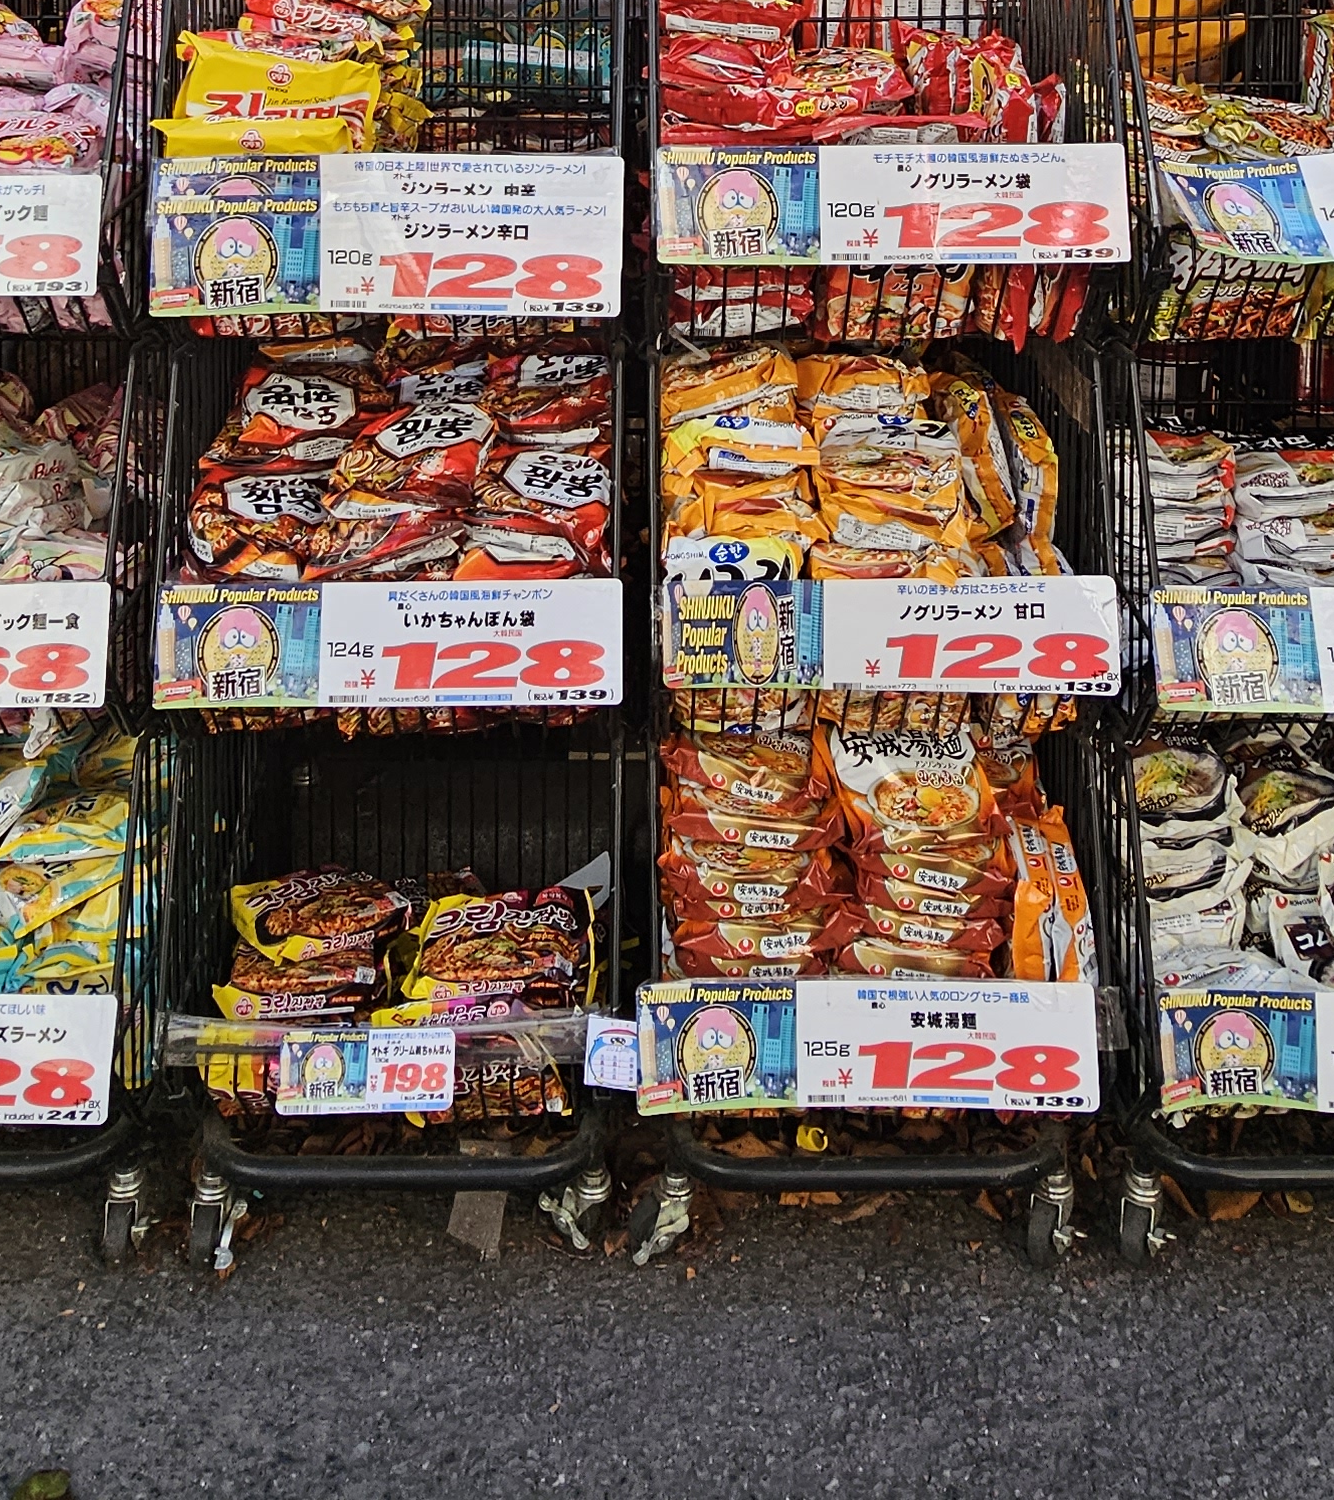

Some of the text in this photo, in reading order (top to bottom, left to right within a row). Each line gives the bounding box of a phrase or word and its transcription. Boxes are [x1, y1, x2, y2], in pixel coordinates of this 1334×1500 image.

[401, 181, 536, 197] ジンラーメン 中辛
[909, 173, 1031, 191] ノグリラーメン袋
[217, 200, 261, 215] Popular
[264, 200, 318, 213] Products
[827, 202, 876, 219] 120g
[404, 223, 529, 240] ジンラーメン辛口
[883, 202, 1110, 248] 128
[713, 229, 763, 257] 新宿
[327, 249, 373, 266] 120g
[379, 253, 603, 298] 128
[209, 277, 262, 306] 新宿
[219, 587, 264, 603] Popular
[266, 587, 319, 601] Products
[678, 595, 735, 621] SHINJUKU
[899, 602, 1045, 621] ノグリラーメン 甘口
[404, 610, 535, 628] いかちゃんぽん袋
[327, 641, 374, 658] 124g
[884, 633, 1110, 680] 128
[381, 640, 606, 690] 128
[211, 669, 263, 698] 新宿
[696, 988, 741, 1004] Popular
[742, 987, 793, 1001] Products
[804, 1040, 851, 1058] 125g
[858, 1040, 1081, 1093] 128
[380, 1063, 449, 1094] 198
